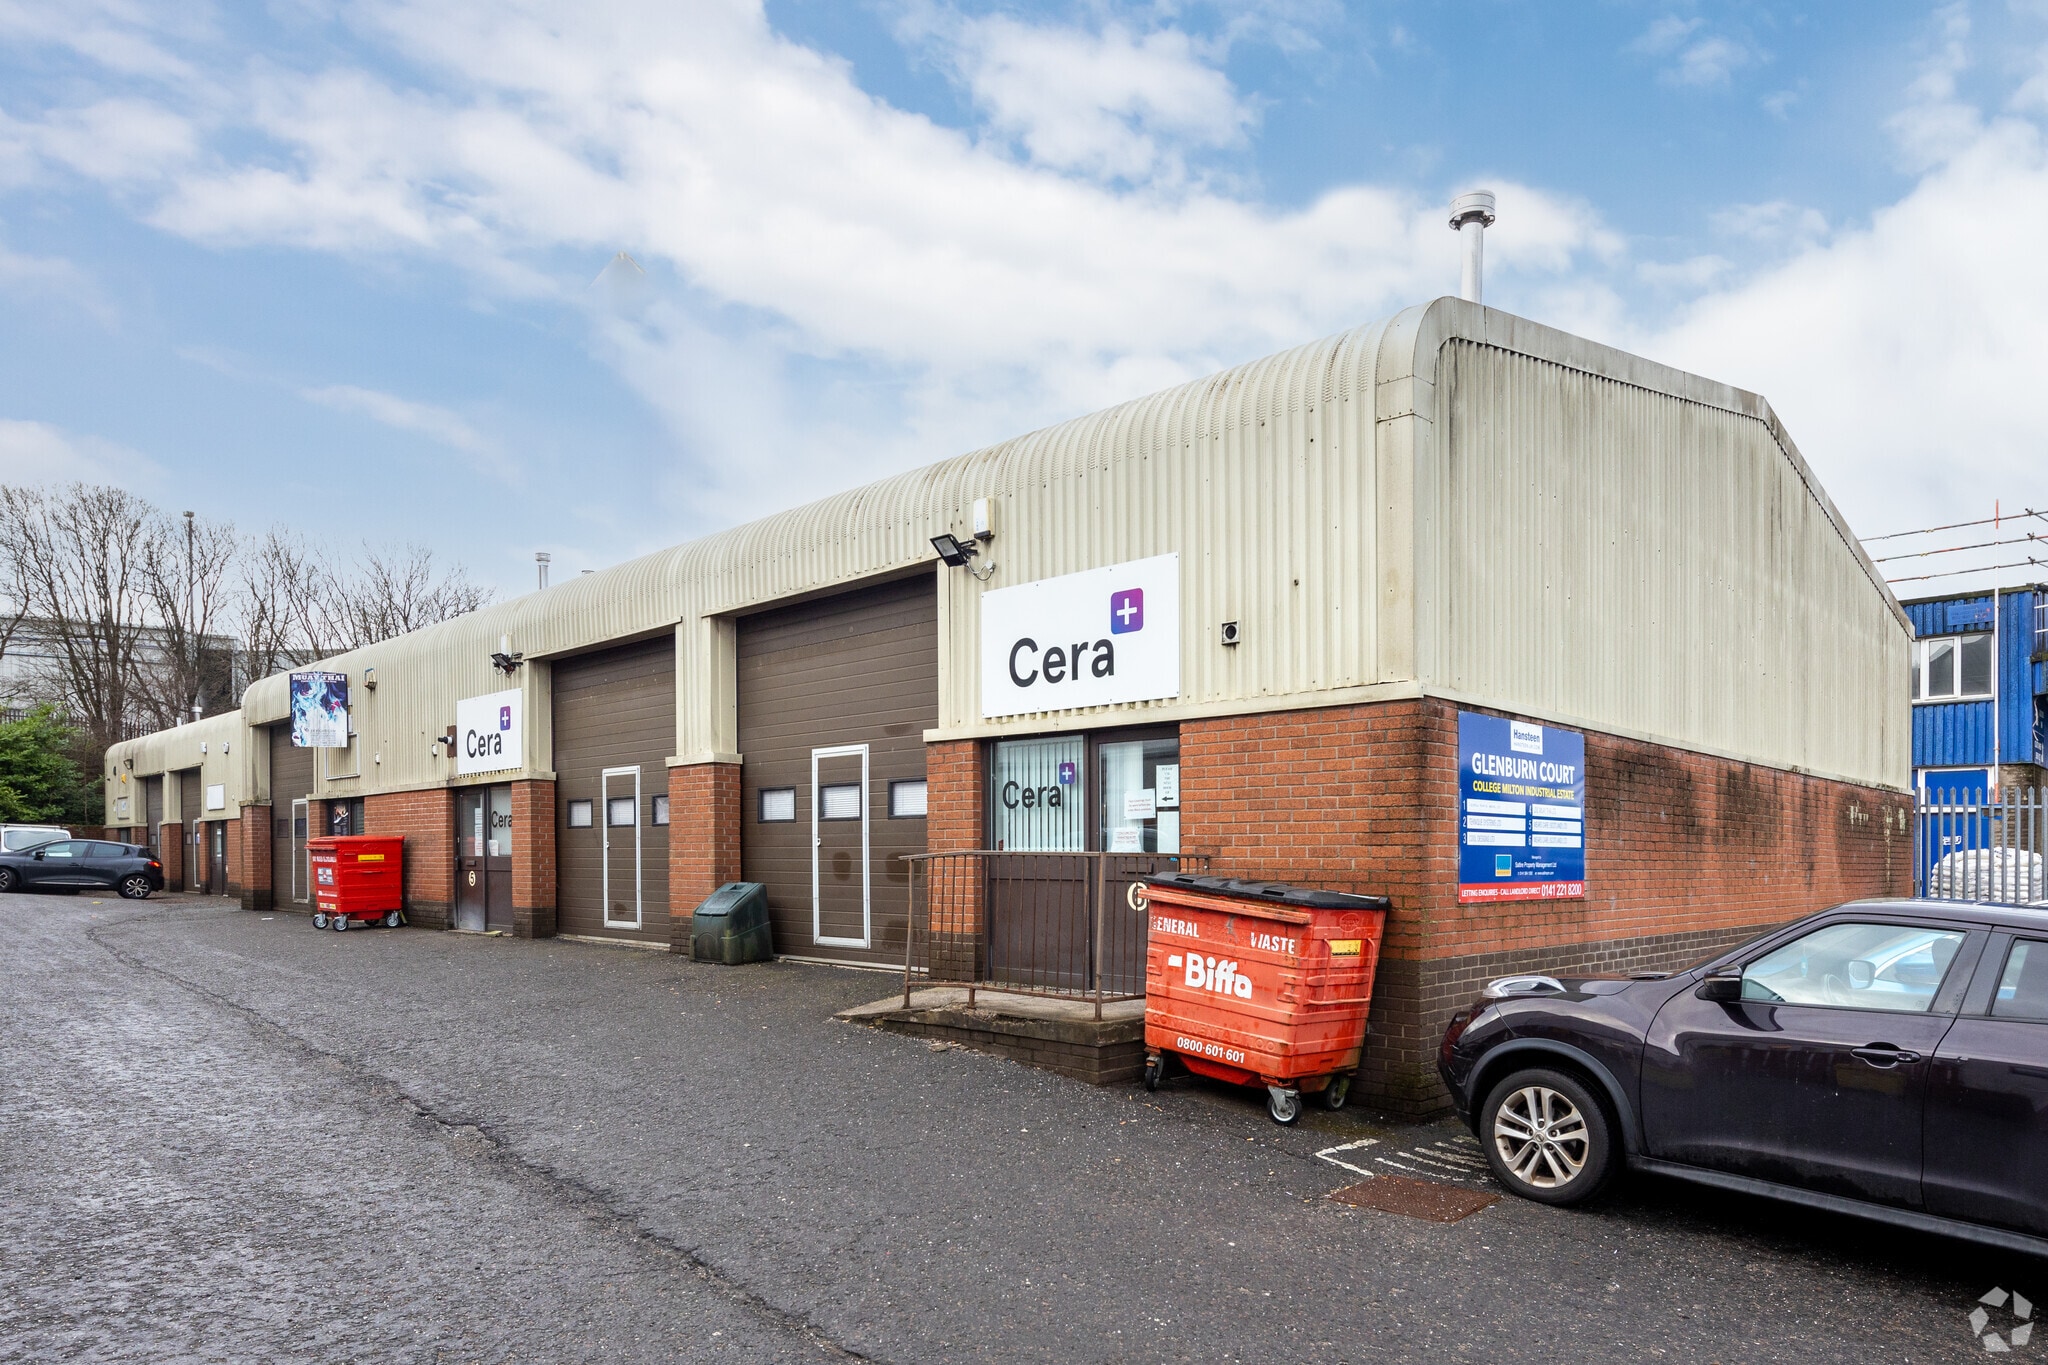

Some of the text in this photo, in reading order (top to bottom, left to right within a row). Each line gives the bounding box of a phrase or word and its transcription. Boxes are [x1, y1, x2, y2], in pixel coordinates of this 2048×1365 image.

[1009, 637, 1115, 688] Cera
[321, 674, 345, 682] THAI
[466, 729, 502, 758] Cera
[1513, 729, 1541, 743] Hansteen
[1471, 752, 1575, 785] GLENBURN COURT
[1002, 780, 1062, 809] Cera
[1473, 780, 1575, 800] COLLEGE MILTON INDUSTRIAL ESTATE
[491, 810, 512, 828] Cera
[1461, 889, 1478, 897] LETTING
[1478, 888, 1498, 896] ENQUIRIES
[1500, 888, 1509, 896] CALL
[1509, 887, 1528, 895] LANDLORD
[1528, 887, 1540, 895] DIRECT
[1541, 884, 1556, 897] 0141
[1556, 883, 1567, 896] 221
[1567, 883, 1582, 895] 8200
[1185, 952, 1253, 999] Biffa
